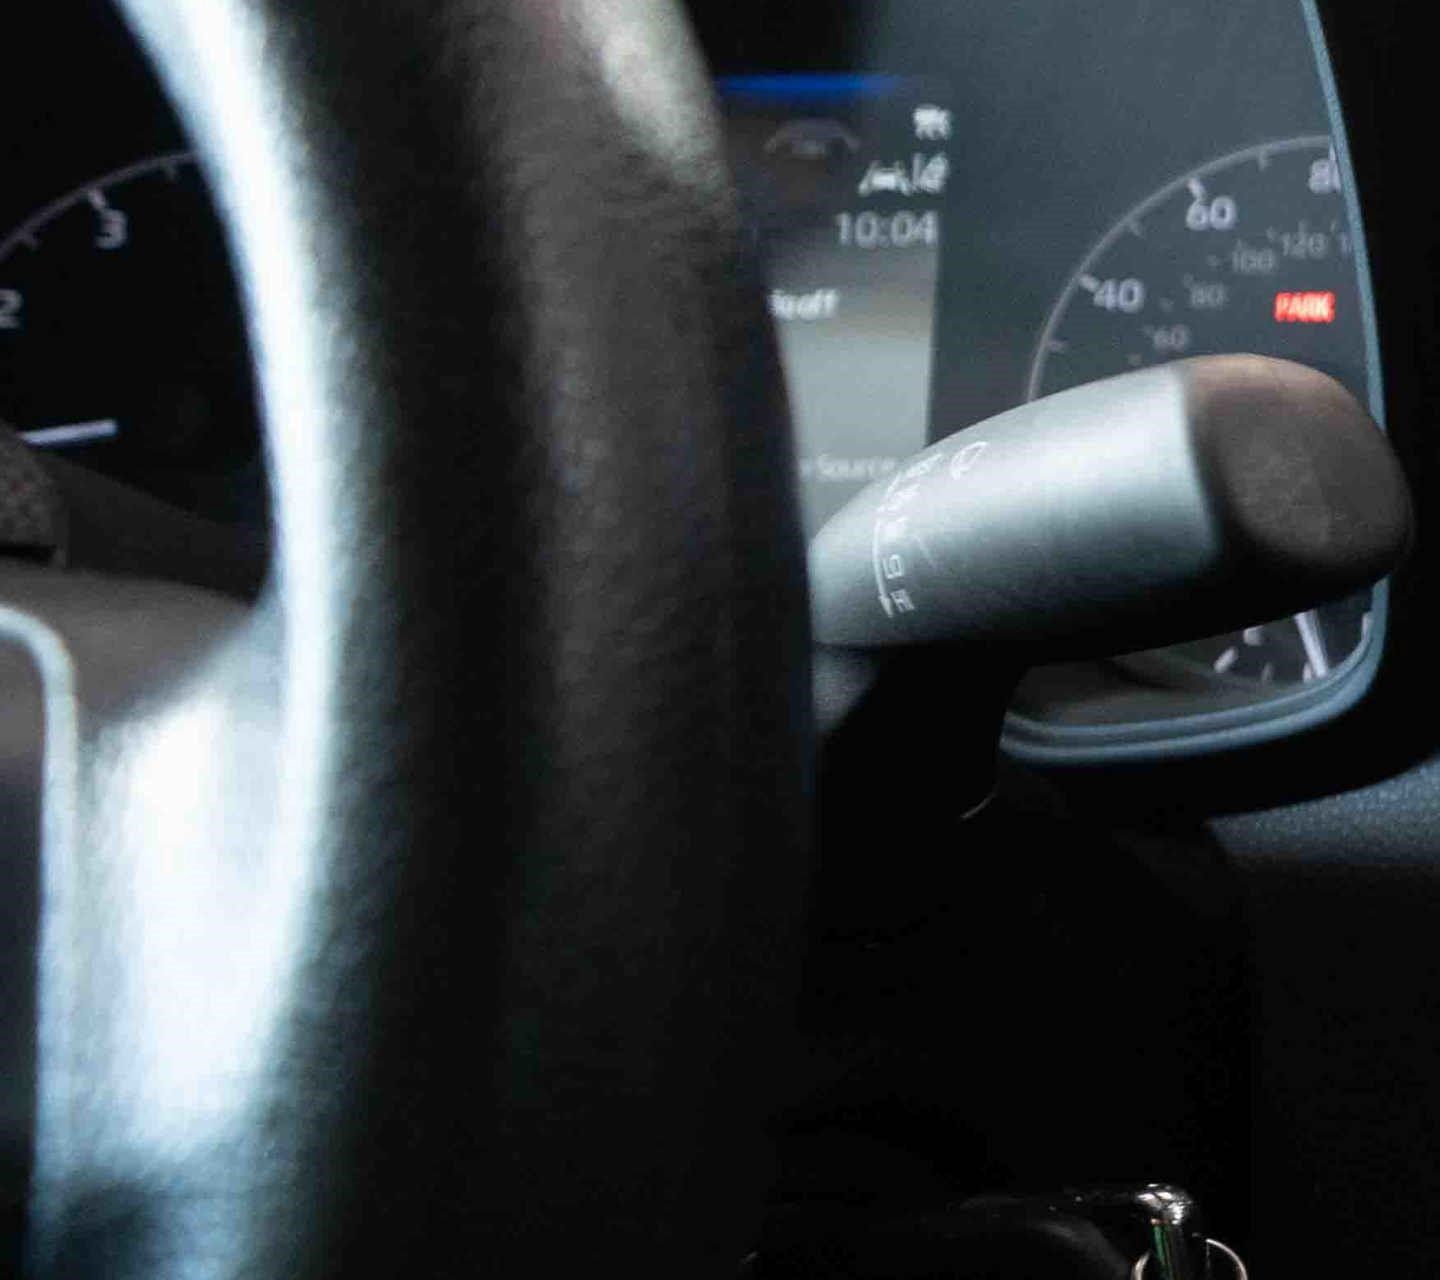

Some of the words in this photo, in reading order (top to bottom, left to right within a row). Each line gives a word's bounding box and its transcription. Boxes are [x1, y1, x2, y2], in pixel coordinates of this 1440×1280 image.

[1309, 159, 1342, 193] 8
[95, 208, 128, 250] 3
[836, 211, 939, 248] 10:04
[1185, 195, 1238, 231] 60
[1092, 277, 1145, 313] 40
[1274, 291, 1336, 323] PARK
